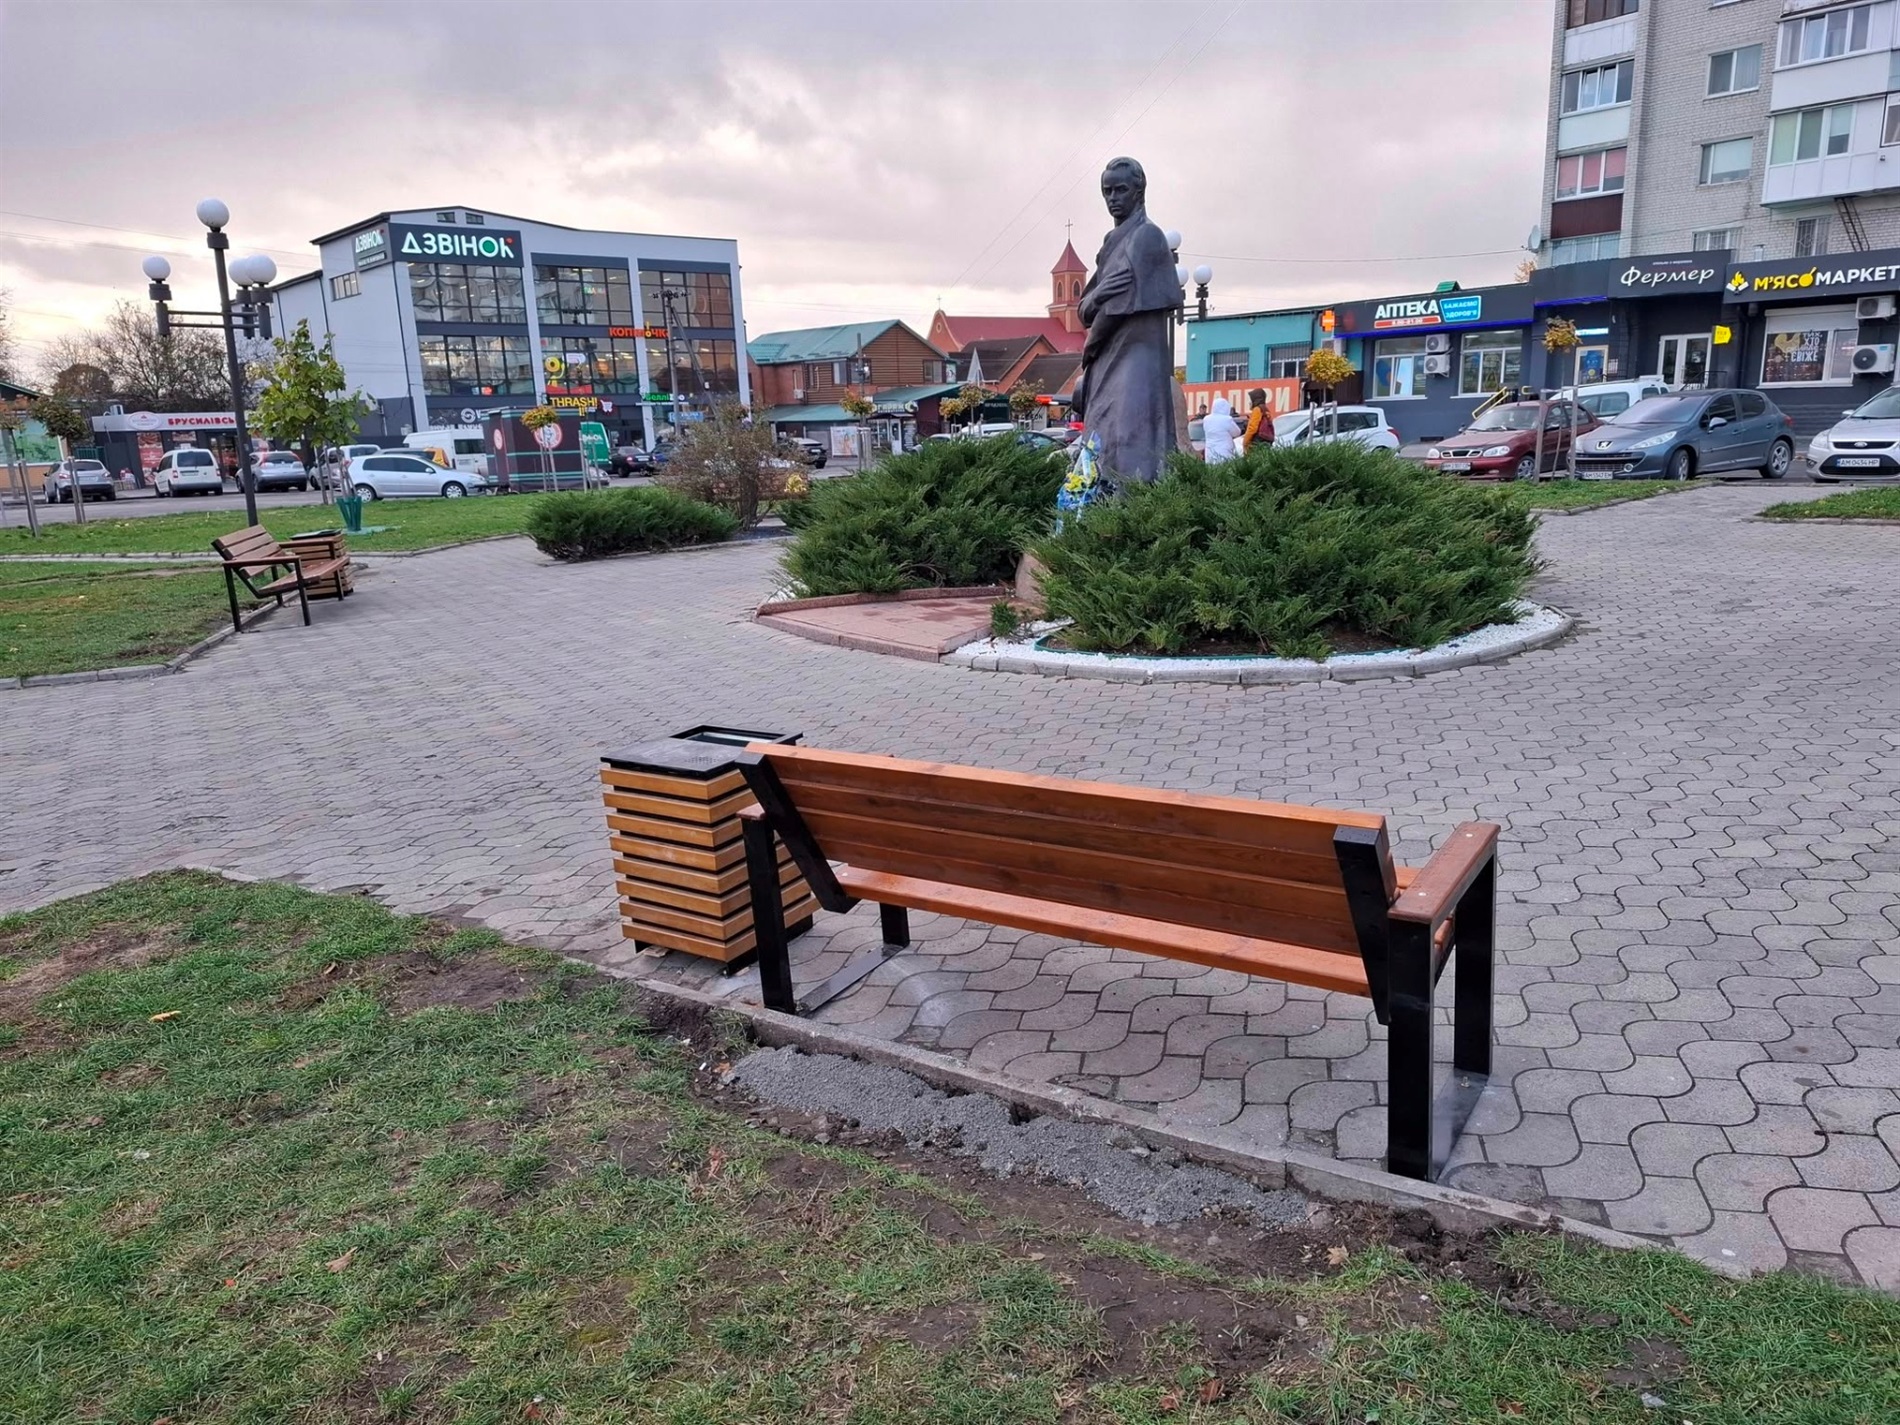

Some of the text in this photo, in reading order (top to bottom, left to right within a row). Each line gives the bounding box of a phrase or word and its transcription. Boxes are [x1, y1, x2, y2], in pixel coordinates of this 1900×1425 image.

[401, 231, 515, 259] ДЗВІНОК
[1620, 265, 1715, 288] Фермер
[1375, 300, 1439, 319] АПТЕКА
[550, 396, 597, 408] THRASH!
